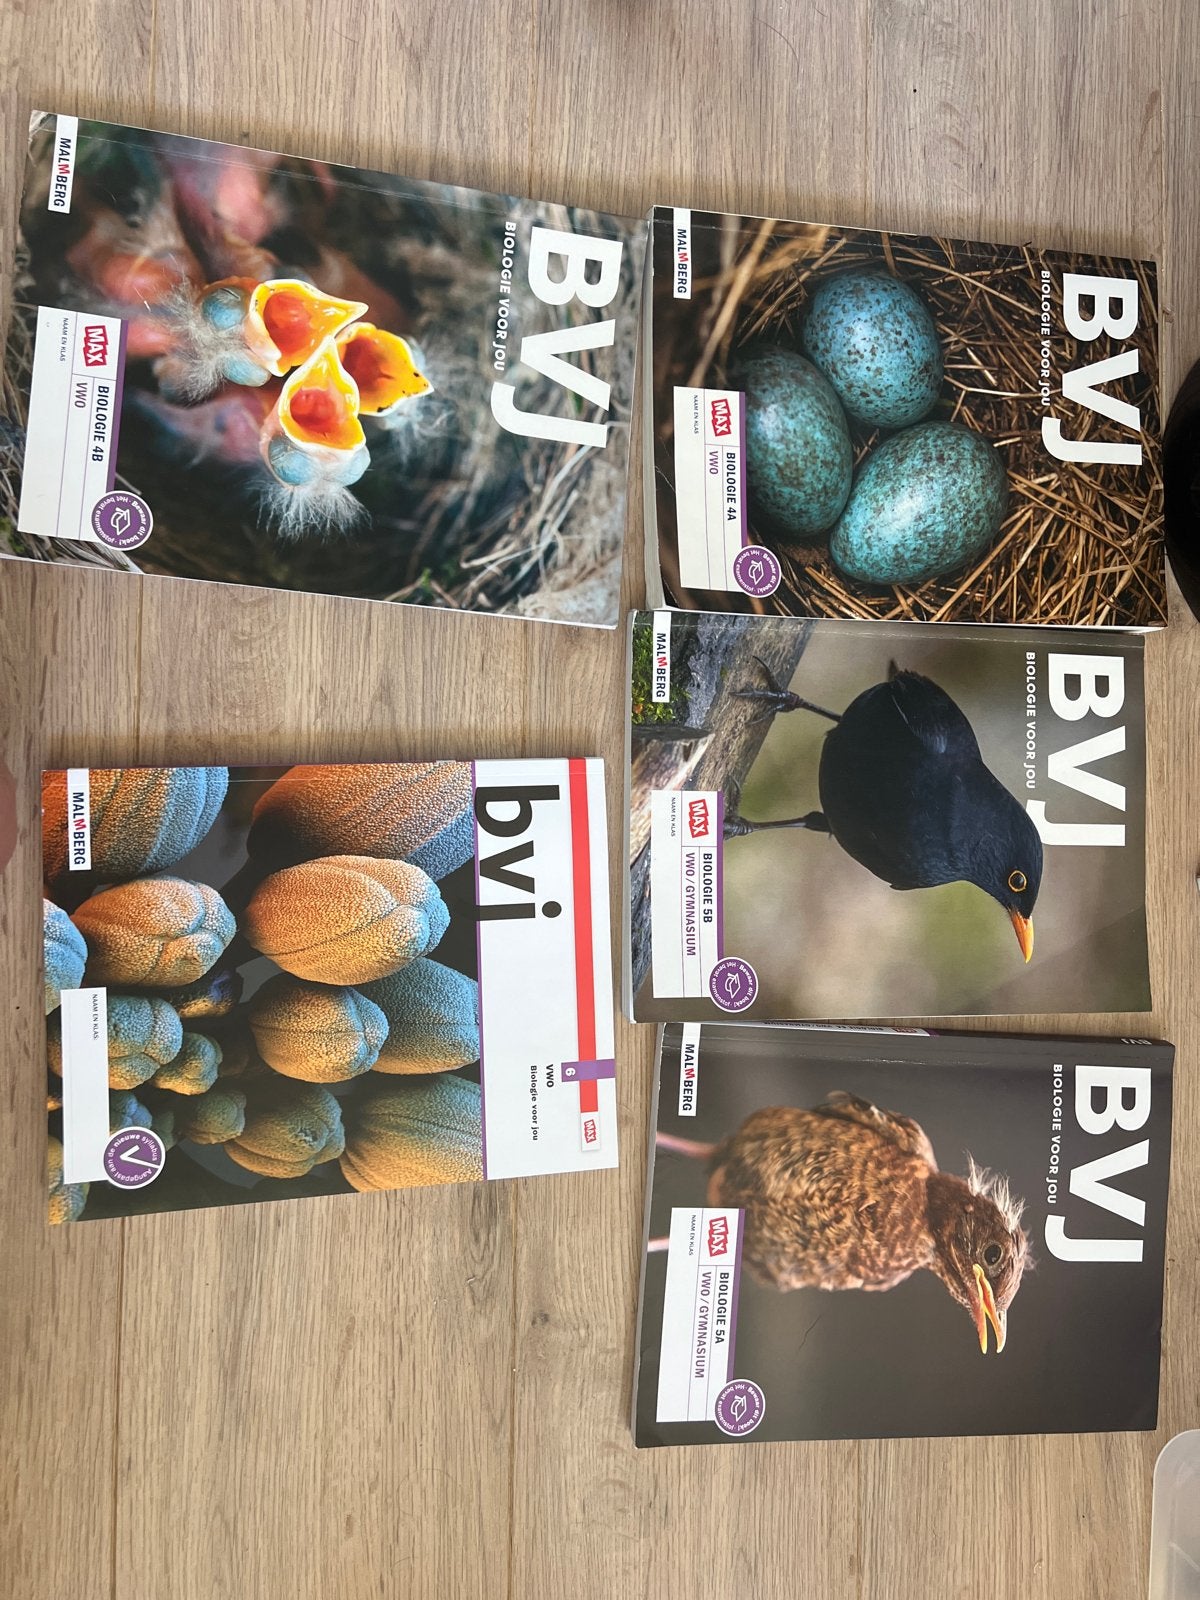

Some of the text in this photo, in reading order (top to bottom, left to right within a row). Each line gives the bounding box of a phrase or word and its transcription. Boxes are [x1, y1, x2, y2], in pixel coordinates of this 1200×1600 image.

[53, 137, 72, 207] MALMBERG
[677, 228, 689, 294] MALMBERG
[494, 221, 516, 370] BIOLOGIE VOOR JOU
[86, 326, 107, 364] MAX
[490, 226, 624, 448] BVJ
[1039, 270, 1051, 406] BIOLOGIE VOOR JOU
[1042, 272, 1142, 466] BVJ
[75, 382, 87, 408] VWO
[92, 386, 109, 462] BIOLOGIE 4B
[712, 400, 731, 435] MAX
[709, 451, 719, 474] VWO
[99, 497, 115, 510] bevat
[726, 452, 736, 521] BIOLOGIE 4A
[95, 510, 114, 543] examenstof
[132, 501, 146, 525] Bewaar
[137, 526, 145, 535] dit
[763, 553, 776, 574] Bewaar
[655, 632, 669, 698] MALMBERG
[1024, 651, 1036, 788] BIOLOGIE VOOR JOU
[1026, 652, 1126, 846] BVJ
[70, 792, 88, 865] MALMBERG
[690, 801, 708, 836] MAX
[459, 784, 562, 922] bvj
[703, 853, 712, 923] BIOLOGIE 5B
[739, 965, 753, 985] Bewaar
[93, 1014, 99, 1022] EN
[566, 1068, 575, 1076] 6
[683, 1044, 696, 1111] MALMBERG
[114, 1134, 140, 1147] nieuwe
[142, 1136, 158, 1161] syllabus
[584, 1120, 596, 1143] MAX
[1046, 1064, 1062, 1204] BIOLOGIE VOOR JOU
[108, 1148, 115, 1157] de
[1044, 1064, 1151, 1263] BVJ
[114, 1168, 152, 1181] Aangepast
[709, 1218, 727, 1255] MAX
[715, 1272, 729, 1344] BIOLOGIE 5A
[748, 1386, 759, 1408] Bewaar
